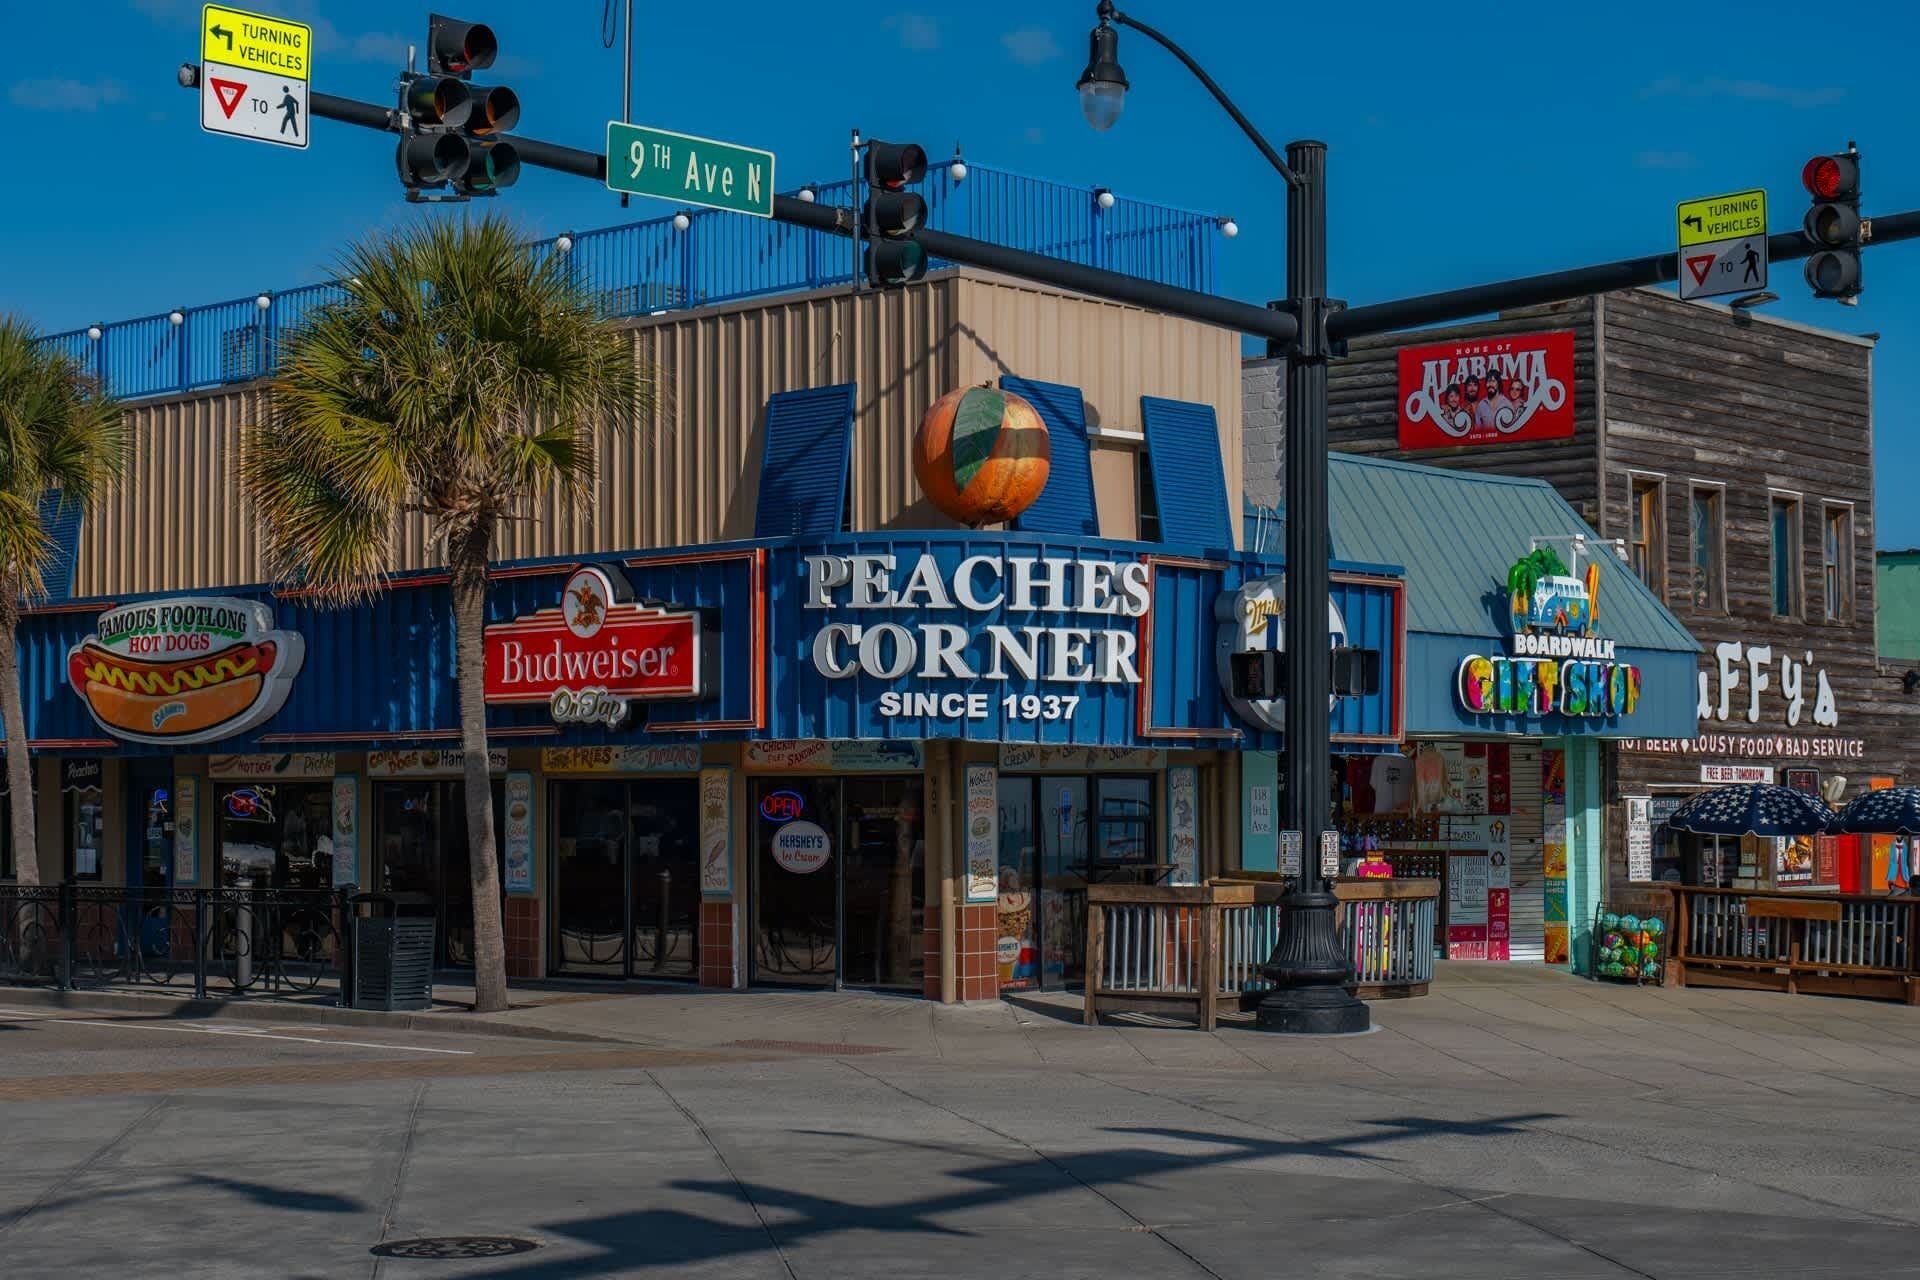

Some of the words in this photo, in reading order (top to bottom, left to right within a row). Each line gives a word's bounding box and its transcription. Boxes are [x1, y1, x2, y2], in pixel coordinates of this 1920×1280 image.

[242, 23, 302, 49] TURNING
[240, 45, 302, 71] VEHICLES
[252, 98, 268, 114] TO
[685, 151, 733, 197] Ave
[748, 163, 761, 204] N
[1708, 198, 1758, 217] TURNING
[1707, 216, 1760, 236] VEHICLES
[1720, 262, 1734, 274] TO
[1456, 346, 1488, 356] HOME
[1497, 343, 1512, 351] OF
[1406, 350, 1566, 434] ALABAMA
[804, 553, 1151, 617] PEACHES
[99, 607, 157, 640] FAMOUS
[160, 605, 247, 633] FOOTLONG
[129, 635, 162, 654] HOT
[166, 633, 210, 652] DOGS
[813, 623, 1143, 684] CORNER
[1514, 633, 1615, 659] BOARDWALK
[501, 635, 675, 684] Budweiser
[1459, 654, 1559, 715] GIFT
[1561, 659, 1642, 717] SHOP
[552, 690, 578, 718] On
[580, 690, 621, 722] Tap
[879, 691, 989, 719] SINCE
[1002, 693, 1080, 720] 1937
[571, 746, 612, 768] FRIES
[788, 742, 825, 766] SANDWICH
[1646, 739, 1678, 752] BEER
[1692, 734, 1735, 755] LOUSY
[1739, 737, 1773, 756] FOOD
[1785, 737, 1809, 756] BAD
[1813, 738, 1864, 757] SERVICE
[389, 752, 418, 774] DOGS
[1706, 767, 1719, 780] FREE
[1720, 767, 1733, 781] BEER
[762, 794, 803, 818] OPEN
[779, 834, 824, 849] HERSHEY'S
